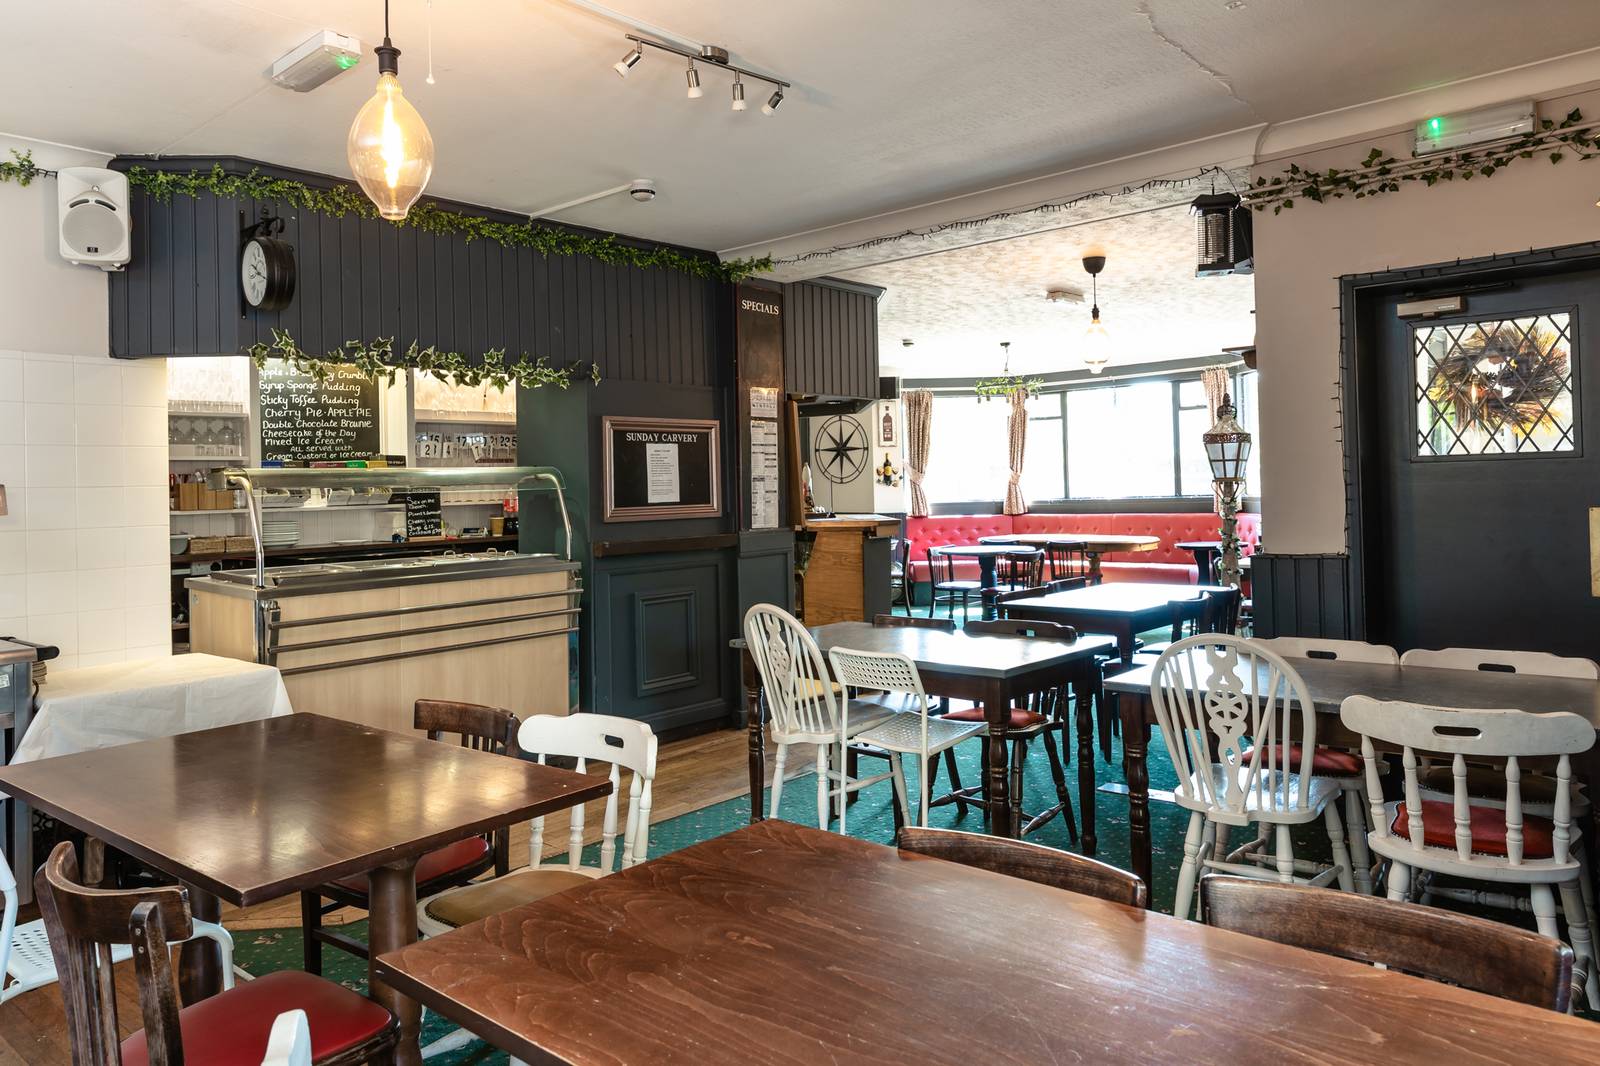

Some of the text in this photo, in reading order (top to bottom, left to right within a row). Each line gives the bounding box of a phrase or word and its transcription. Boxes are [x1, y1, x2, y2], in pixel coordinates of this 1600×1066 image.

[741, 299, 779, 315] SPECIALS
[259, 368, 283, 380] Apple
[259, 380, 361, 397] Syrup Sponge Pudding
[260, 394, 360, 410] Sticky Toffee Pudding
[265, 408, 301, 421] Cherry
[356, 408, 372, 417] PIE
[262, 419, 374, 430] Double Chocolate Brownie
[262, 429, 357, 442] Cheesecake of the Day
[265, 437, 293, 446] Mixed
[315, 437, 344, 445] Cream
[626, 432, 698, 443] SUNDAY CARVERY
